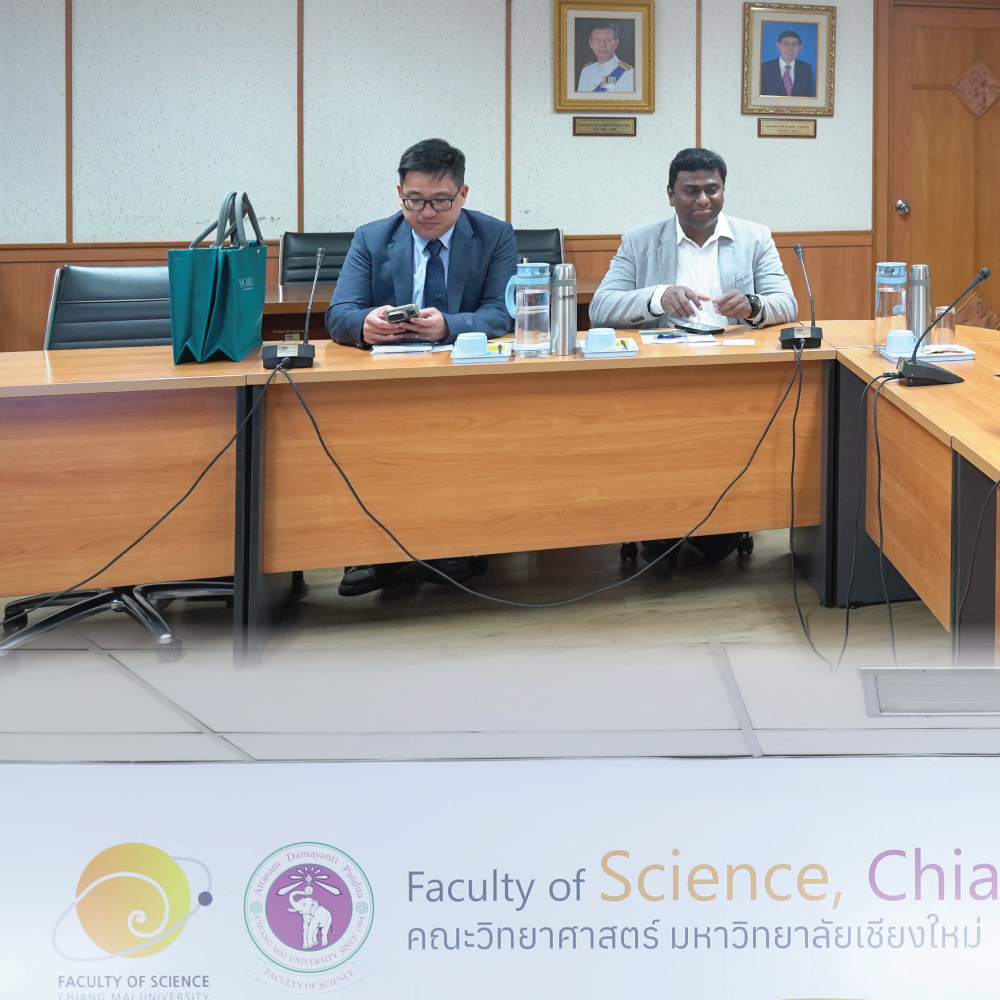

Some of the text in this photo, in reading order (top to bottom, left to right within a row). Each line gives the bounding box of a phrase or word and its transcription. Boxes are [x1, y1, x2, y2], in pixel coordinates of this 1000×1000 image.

[286, 851, 339, 864] Damayanti
[408, 869, 536, 911] Faculty
[549, 868, 587, 902] of
[601, 849, 842, 910] Science,
[254, 915, 365, 966] CHIANG MAI UNIVERSITY SINCE 1964
[408, 913, 981, 950] คณะวิทยาศาสตร์ มหาวิทยาลัยเชียงใหม่
[58, 975, 210, 988] FACULTY OF SCIENCE
[264, 968, 355, 990] FACULTY OF SCIENCE
